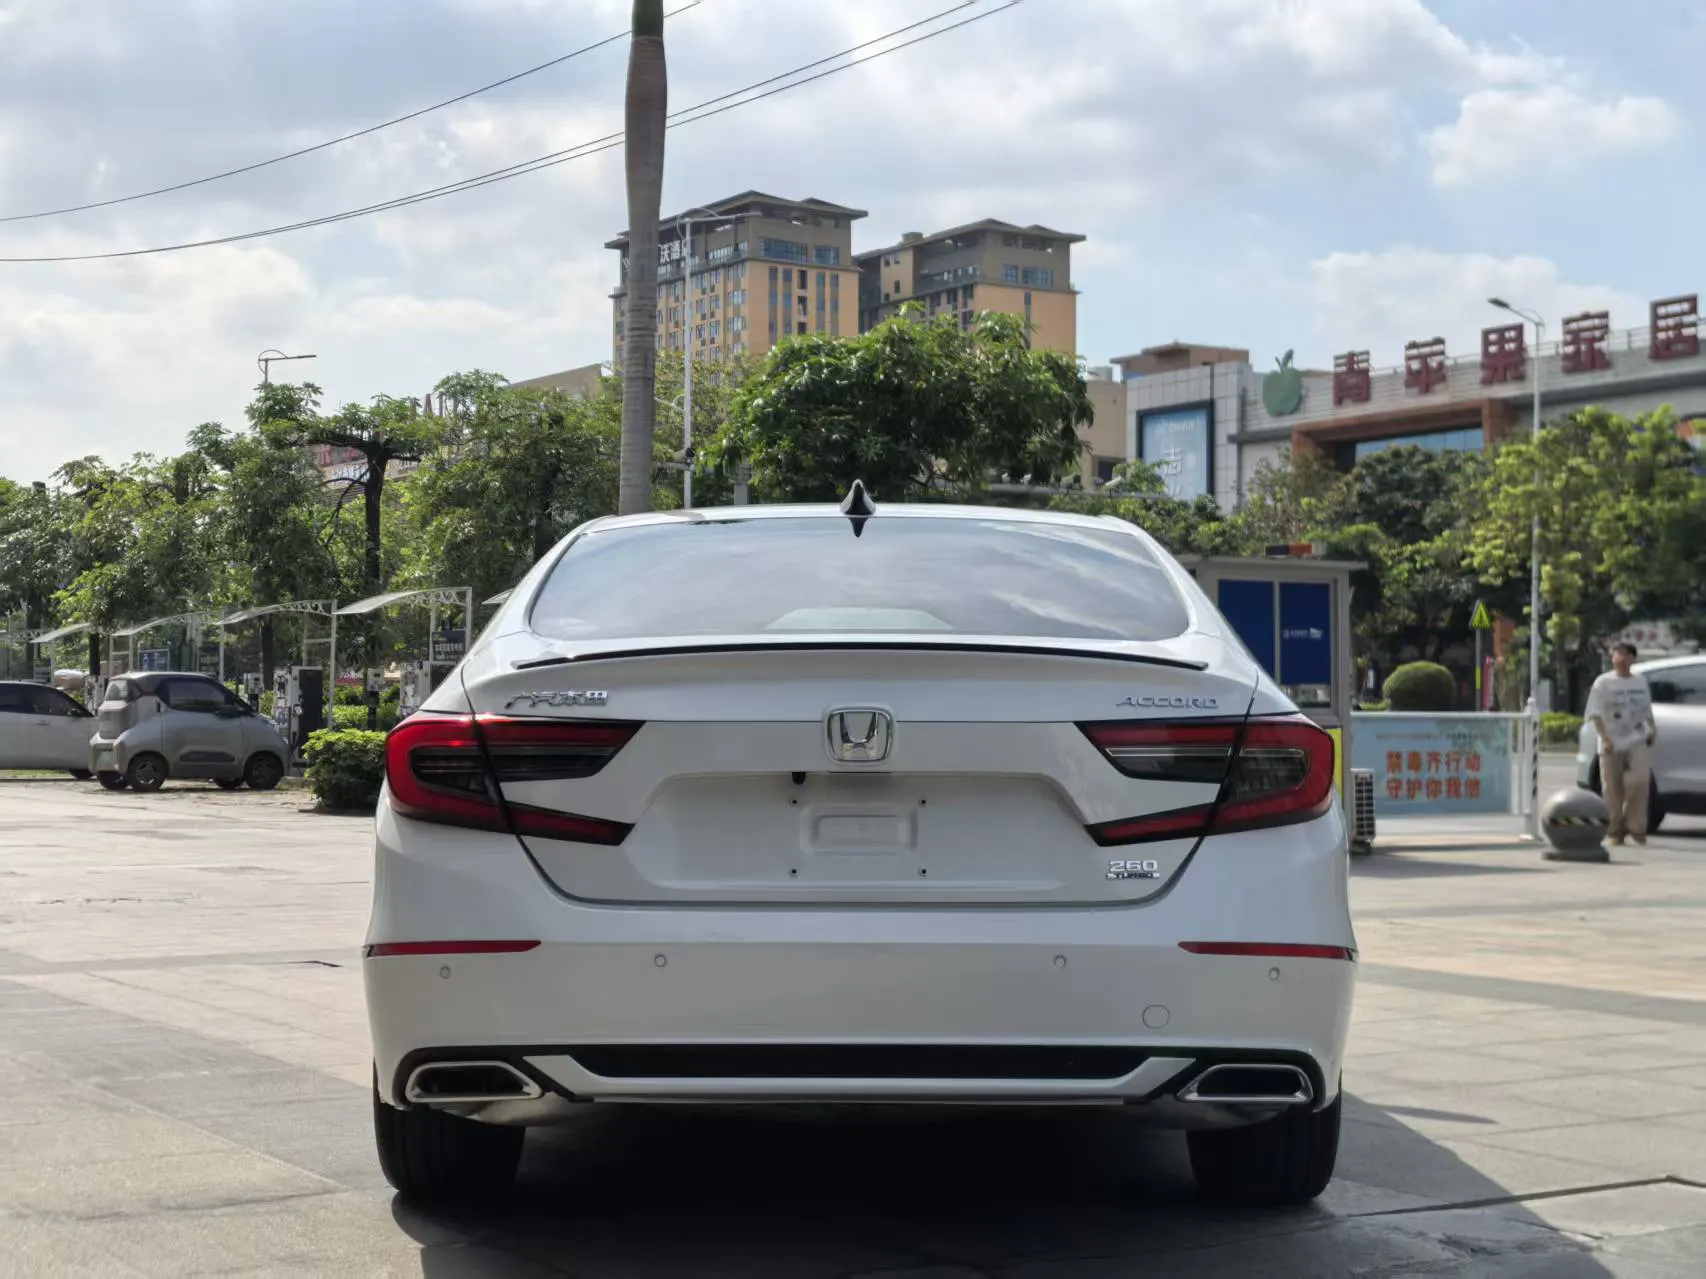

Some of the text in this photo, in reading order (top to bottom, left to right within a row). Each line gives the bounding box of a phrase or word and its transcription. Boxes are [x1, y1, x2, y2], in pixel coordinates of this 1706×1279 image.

[1115, 696, 1219, 710] ACCORD
[1386, 750, 1481, 774] 禁毒齐行动
[1386, 776, 1481, 800] 守护你我他
[1109, 859, 1158, 871] 260
